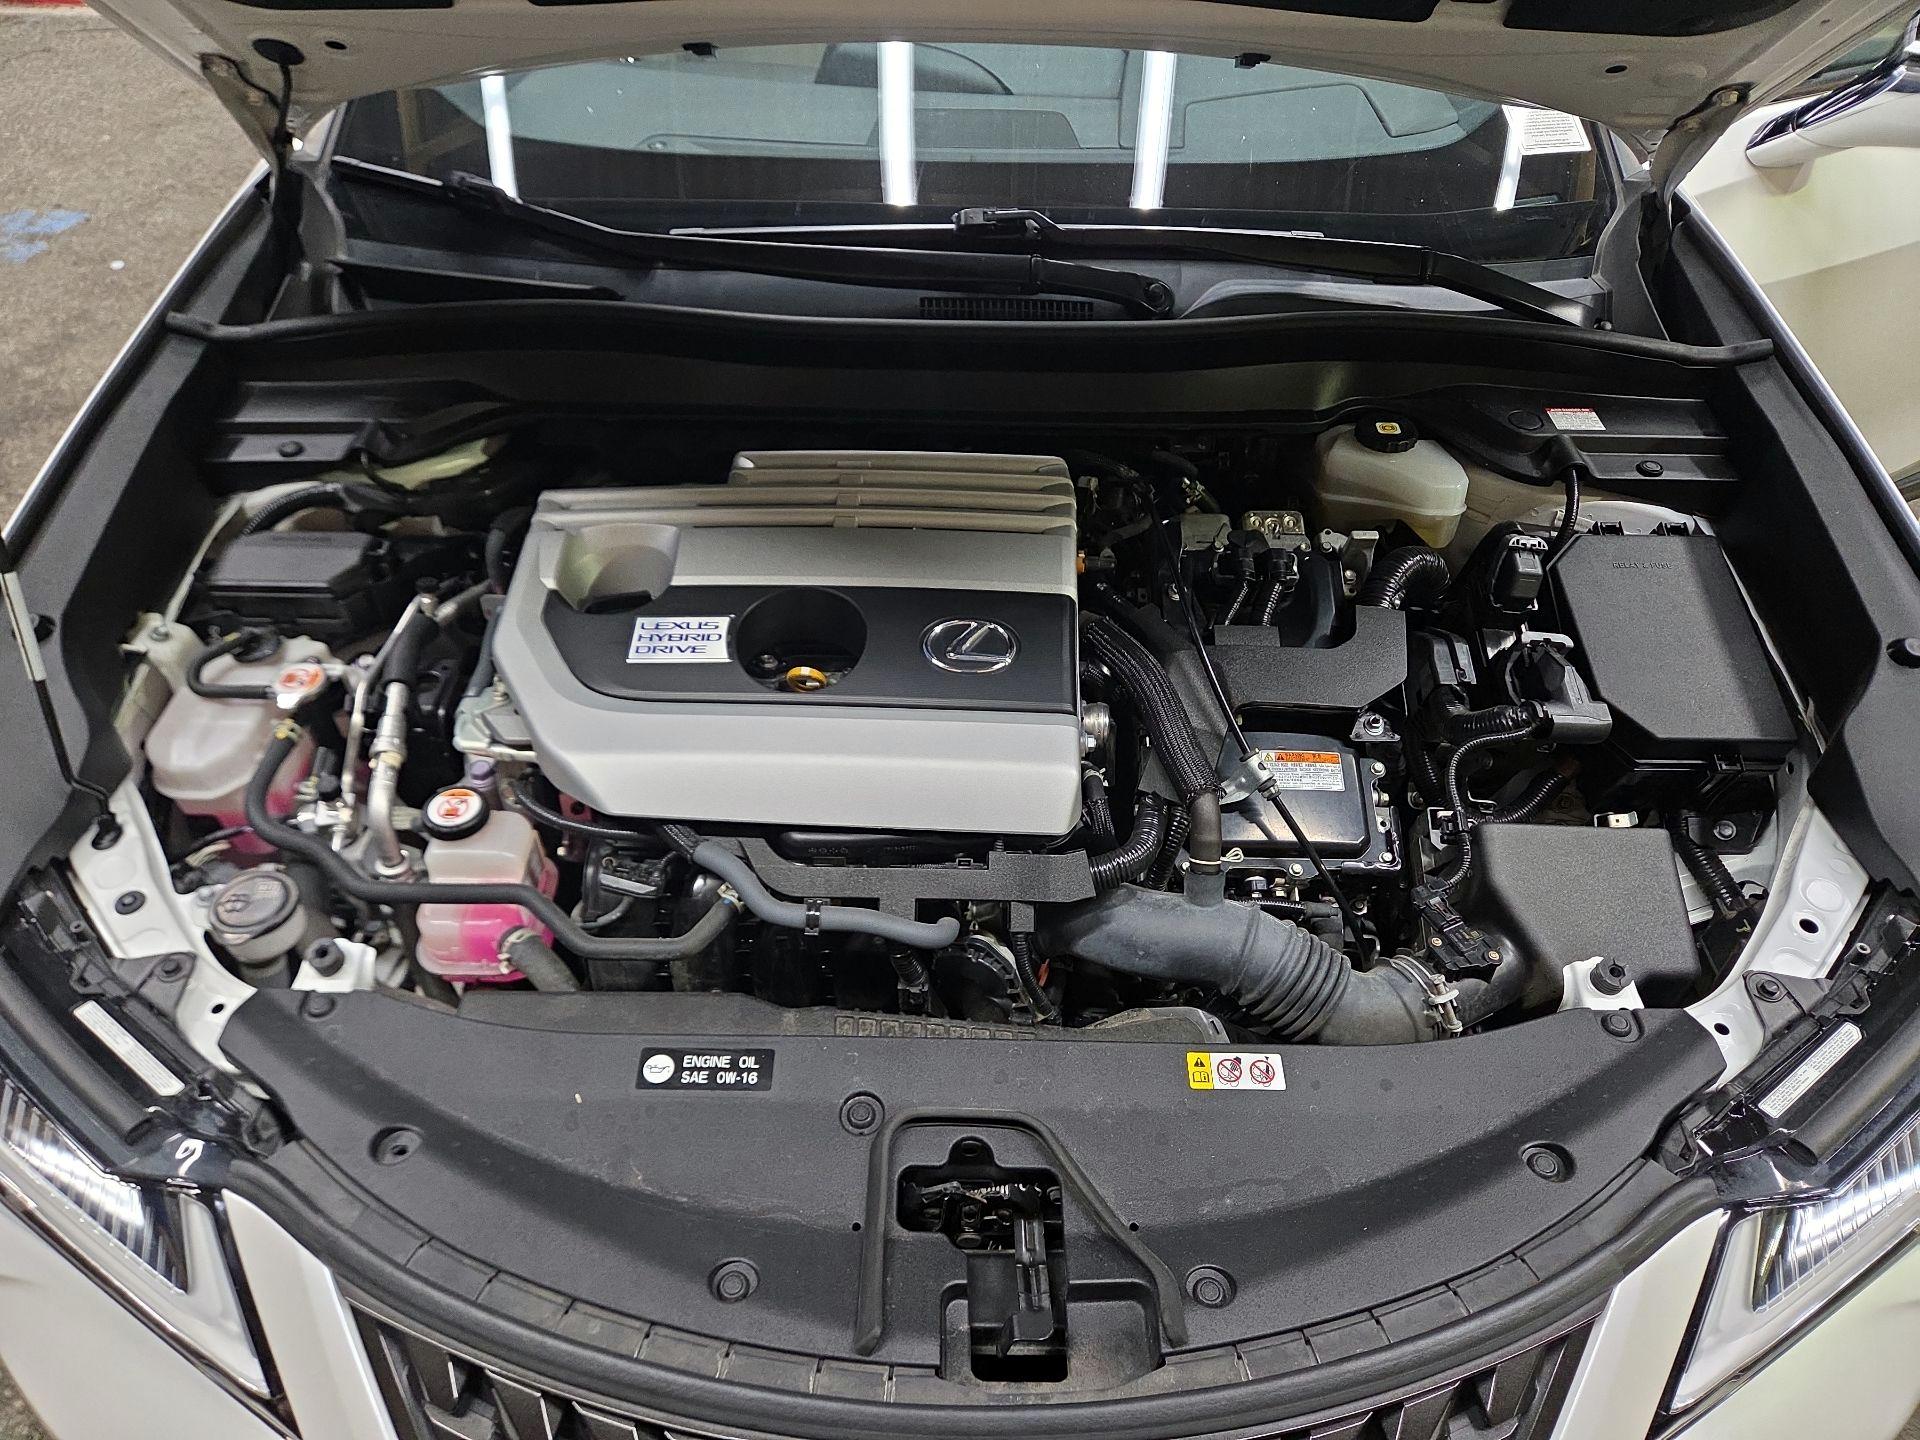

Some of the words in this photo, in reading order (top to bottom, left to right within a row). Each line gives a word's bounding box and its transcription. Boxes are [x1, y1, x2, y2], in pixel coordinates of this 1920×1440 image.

[641, 621, 719, 630] LEXUS
[637, 633, 722, 642] HYBRID
[635, 645, 707, 654] DRIVE
[682, 1055, 732, 1068] ENGINE
[738, 1056, 760, 1069] OIL
[680, 1071, 709, 1084] SAE
[716, 1071, 758, 1085] 0W-16
